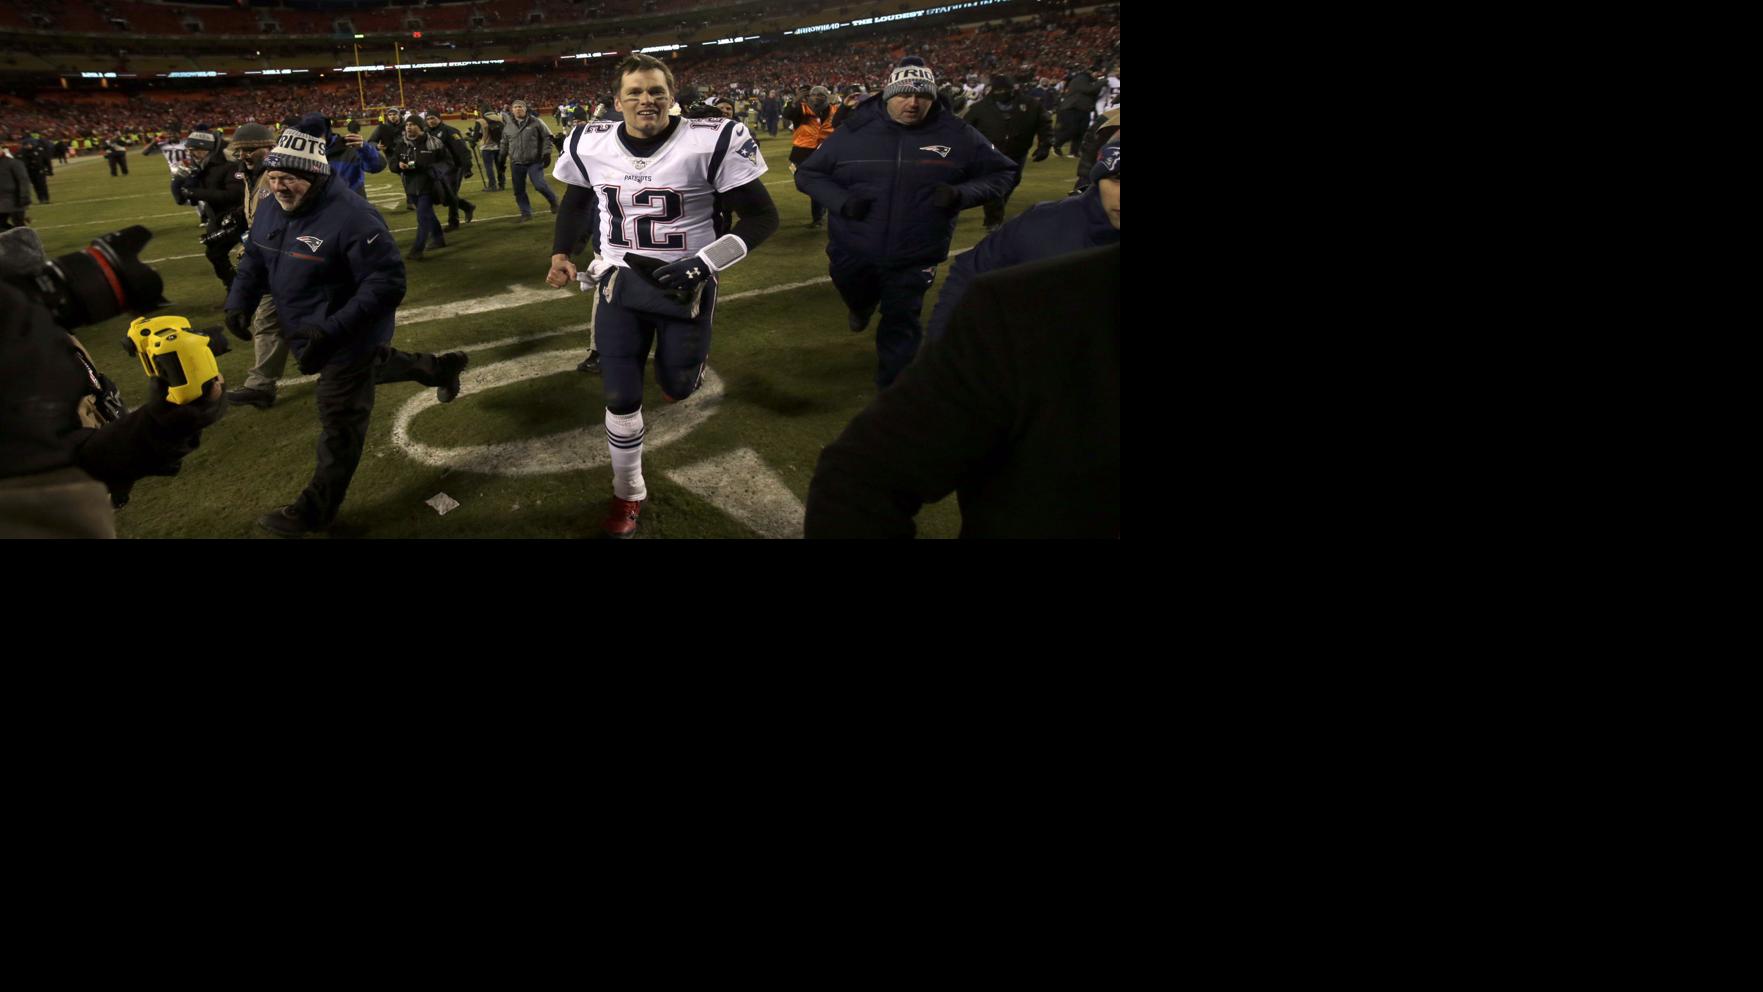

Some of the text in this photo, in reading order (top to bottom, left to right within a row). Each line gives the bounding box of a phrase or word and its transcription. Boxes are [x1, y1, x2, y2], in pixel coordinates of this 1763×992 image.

[851, 18, 874, 27] THE
[874, 10, 925, 23] LOUDEST
[600, 184, 687, 251] 12
